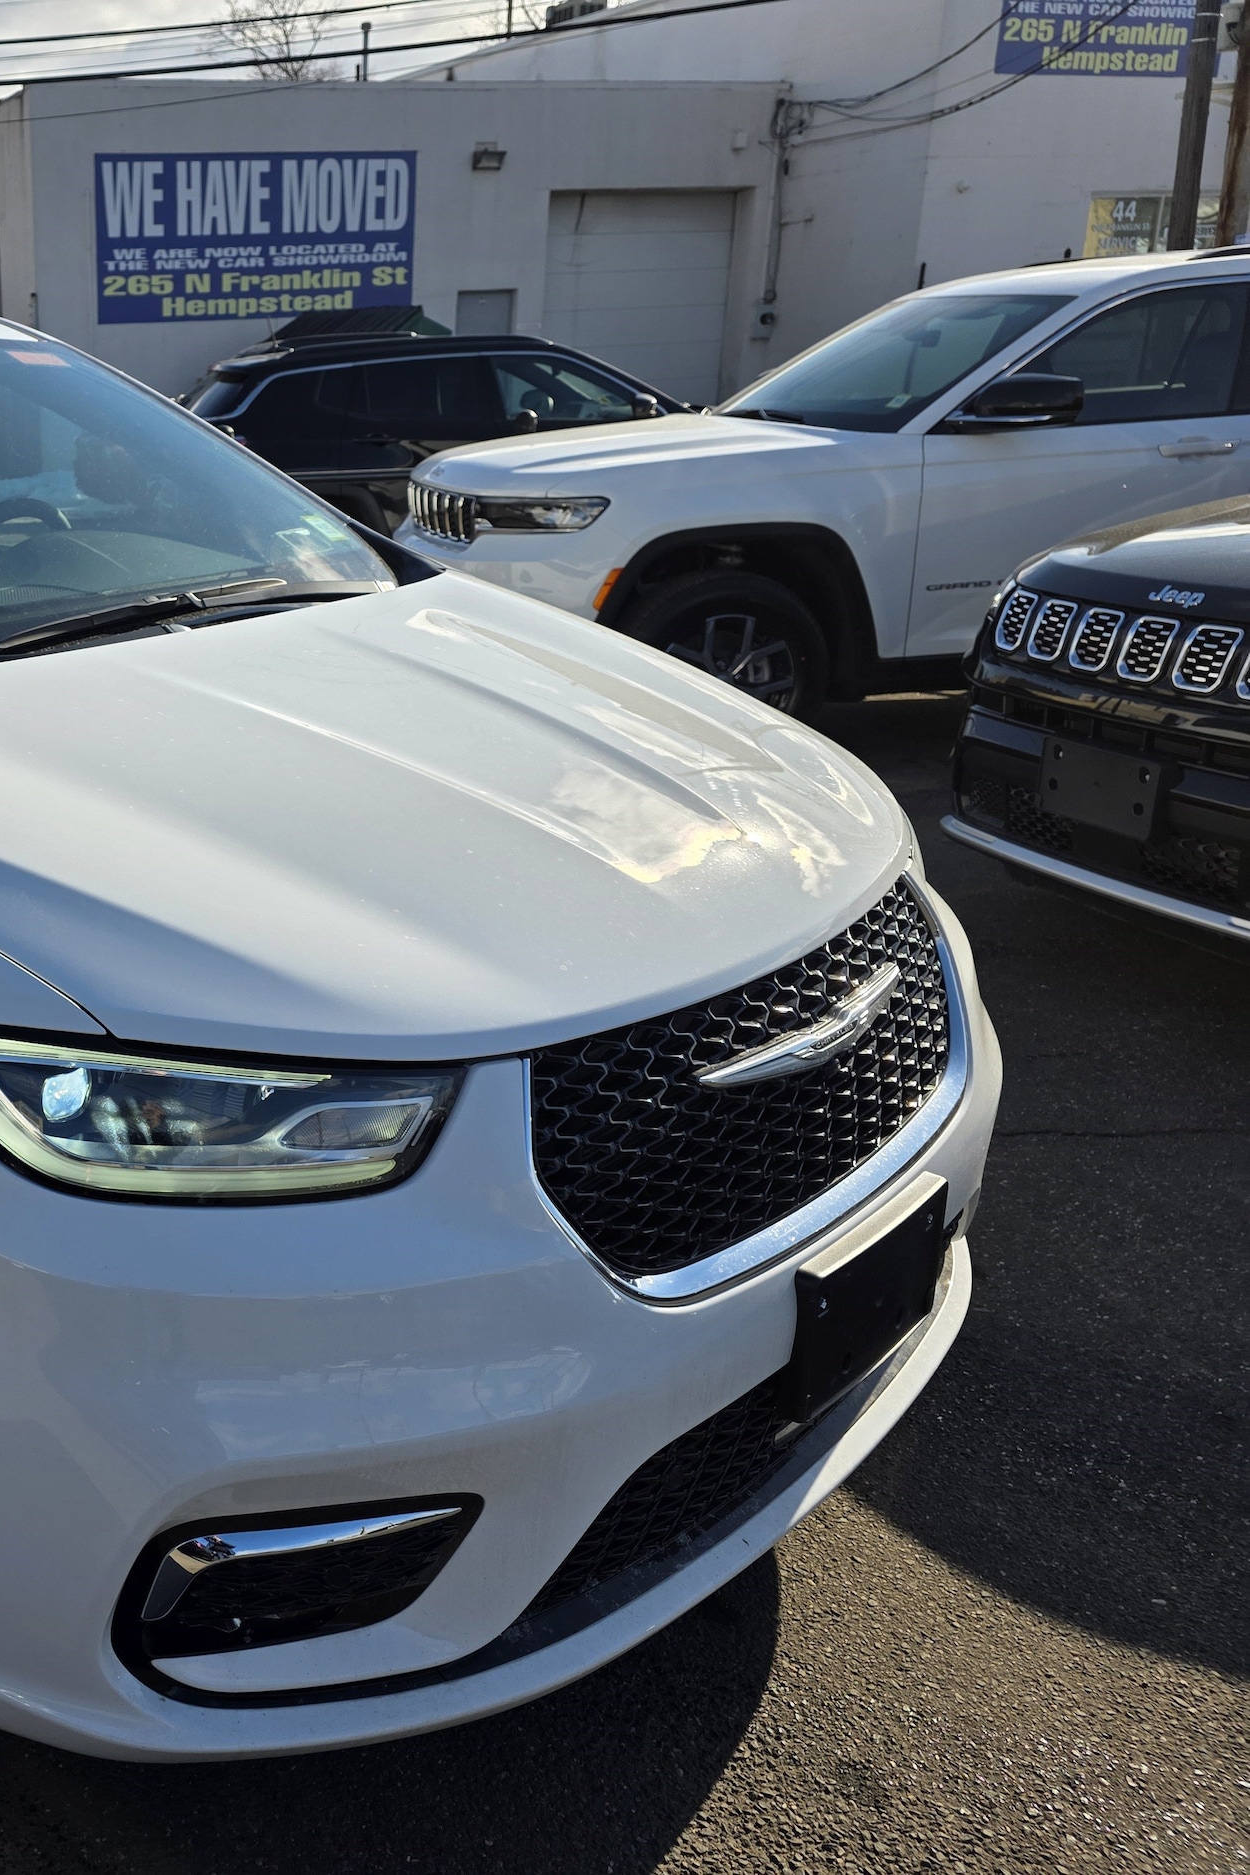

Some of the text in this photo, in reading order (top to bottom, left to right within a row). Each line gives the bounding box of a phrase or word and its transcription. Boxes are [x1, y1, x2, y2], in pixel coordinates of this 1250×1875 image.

[1009, 1, 1196, 19] THE NEW CAR SHOWRO
[1003, 17, 1188, 46] 265 N Franklin
[1042, 46, 1179, 74] Hempstead
[101, 157, 410, 238] WE HAVE MOVED
[1112, 200, 1137, 222] 44
[112, 242, 399, 260] WE ARE NOW LOCATED AT
[1099, 236, 1140, 250] SERVIC
[104, 251, 408, 271] THE NEW CAR SHOWROOM
[102, 266, 409, 296] 265 N Franklin St
[162, 290, 354, 317] Hempstead
[926, 580, 992, 591] GRAND
[1148, 584, 1206, 609] Jeep
